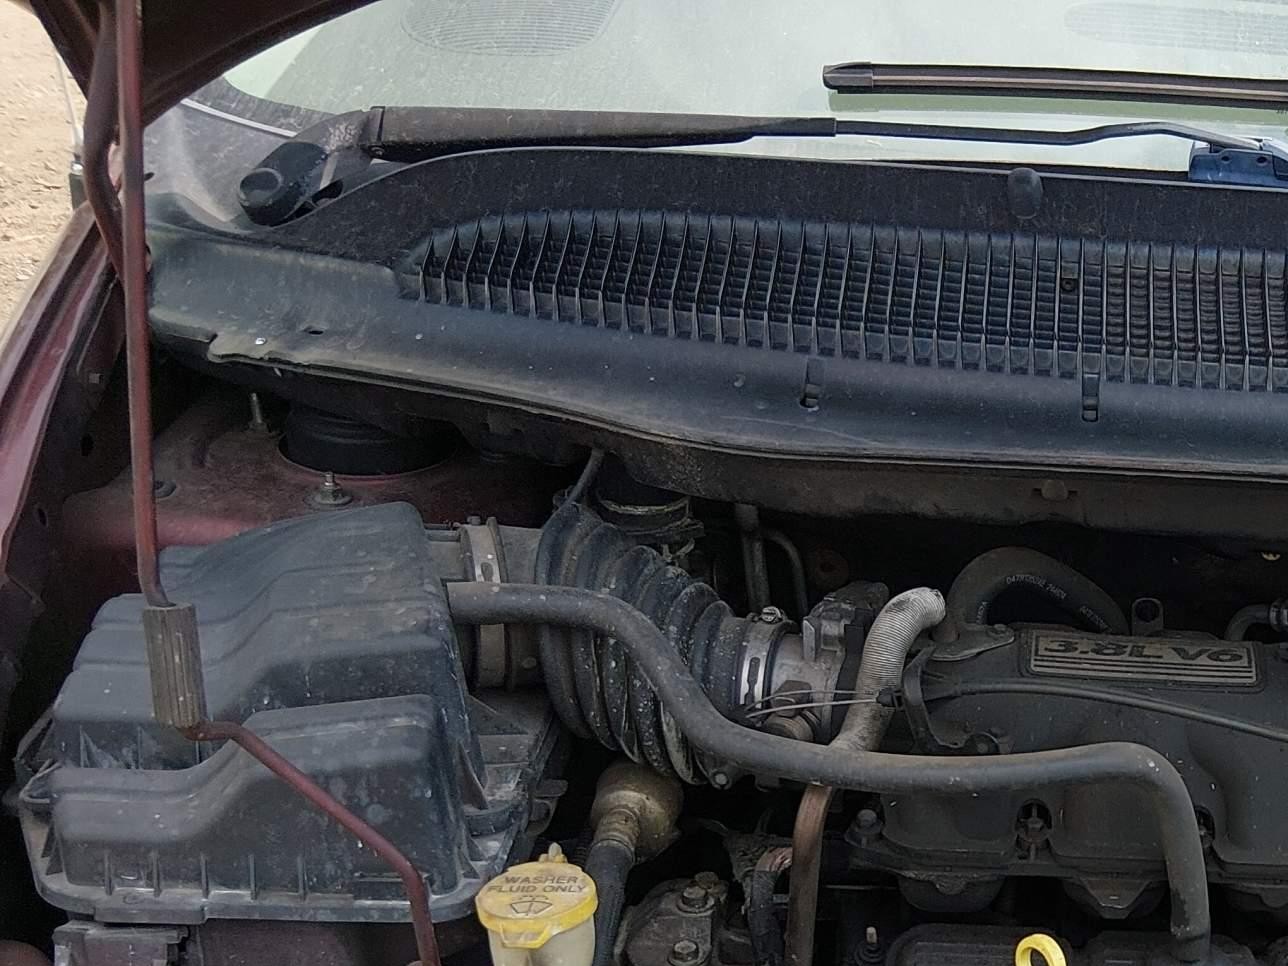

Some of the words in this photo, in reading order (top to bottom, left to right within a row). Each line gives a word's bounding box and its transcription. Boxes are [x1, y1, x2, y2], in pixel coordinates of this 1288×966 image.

[1044, 639, 1163, 660] 3.8L
[1169, 646, 1243, 664] V6
[504, 875, 579, 885] WASHER
[487, 885, 538, 894] FLUID
[542, 885, 586, 894] ONLY
